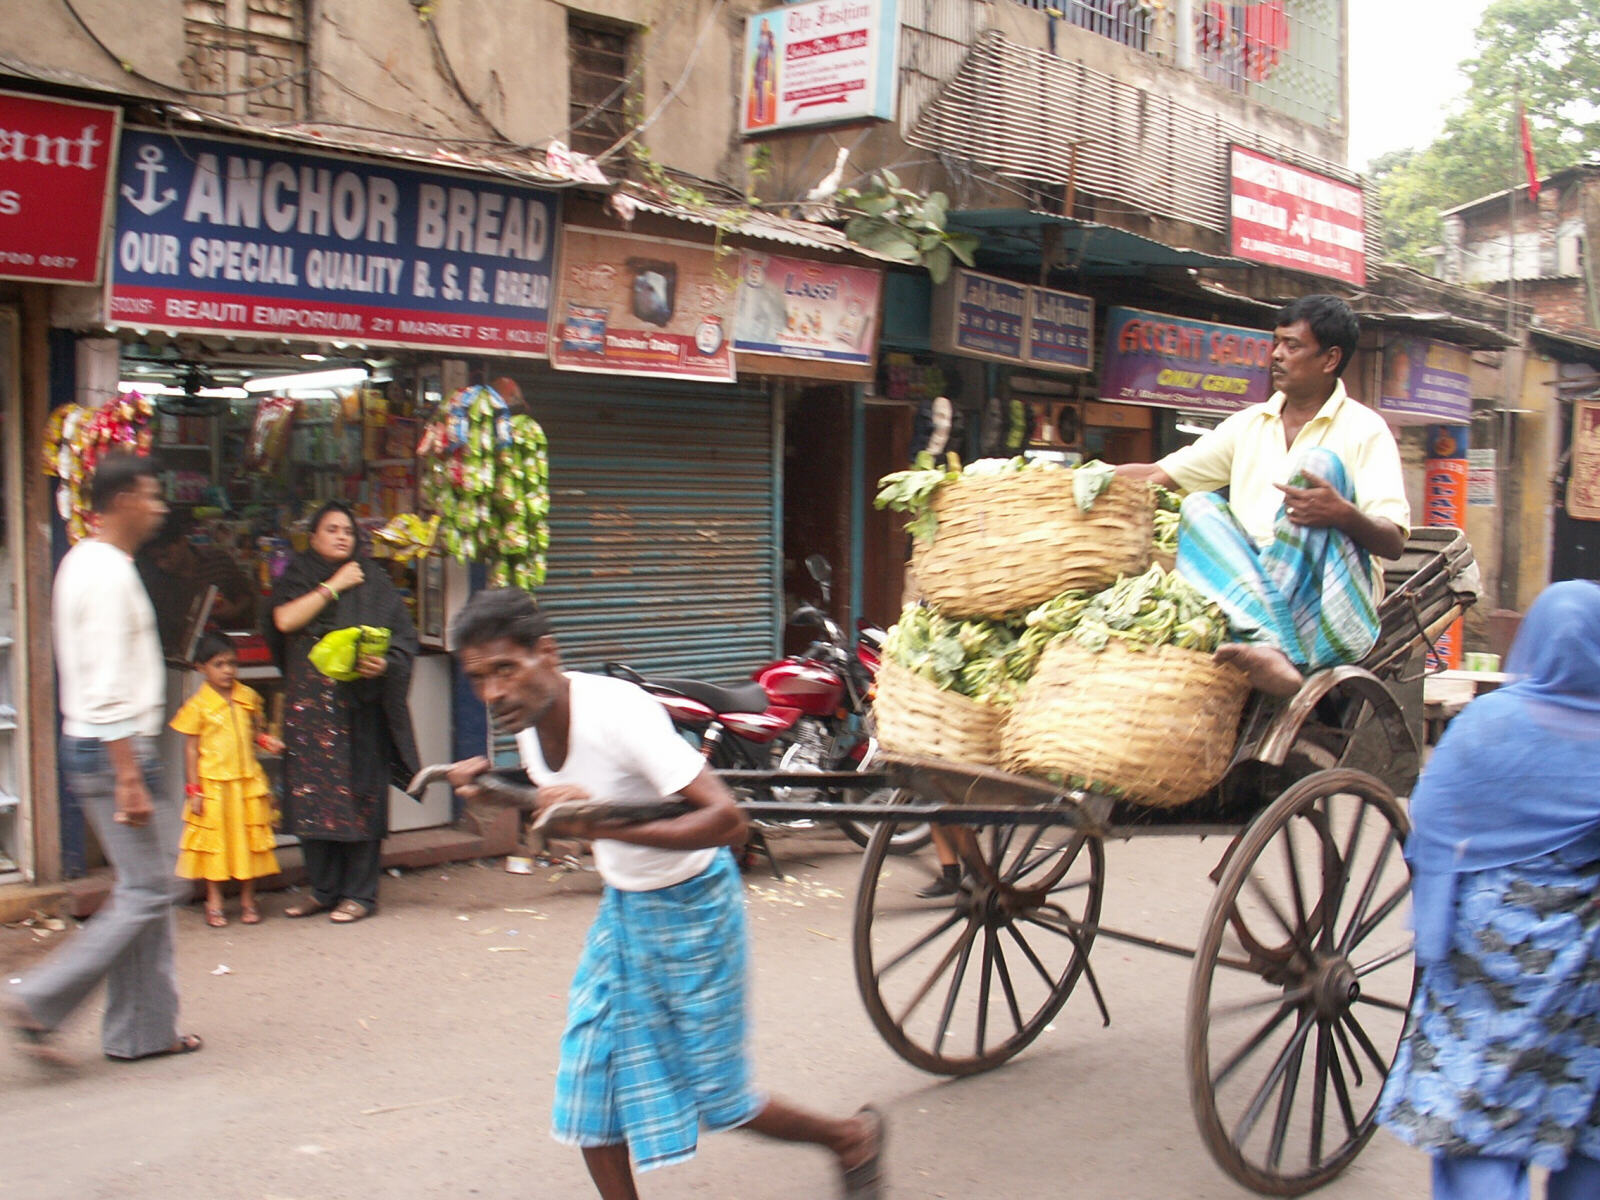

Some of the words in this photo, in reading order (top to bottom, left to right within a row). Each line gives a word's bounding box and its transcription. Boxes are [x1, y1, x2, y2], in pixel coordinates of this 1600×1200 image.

[183, 152, 399, 245] ANCHOR
[416, 182, 549, 262] BREAD
[119, 229, 181, 276] OUR
[188, 236, 298, 287] SPECIAL
[305, 248, 404, 296] QUALITY
[412, 259, 437, 298] B.
[441, 262, 464, 300] S.
[468, 265, 490, 303] B.
[494, 268, 549, 310] BREAD
[784, 272, 840, 300] Lassi
[165, 297, 248, 323] BEAUTI
[252, 304, 365, 334] EMPORIUM,
[370, 317, 395, 333] 21
[397, 319, 474, 339] MARKET
[477, 326, 503, 342] ST.
[960, 274, 1025, 318] Lakhani
[1031, 292, 1090, 328] Lakhani
[959, 311, 1022, 338] SHOES
[1030, 328, 1089, 350] SHOES
[1118, 318, 1206, 361] ACCENT
[1208, 331, 1273, 368] SALOO
[1156, 368, 1203, 389] ONLY
